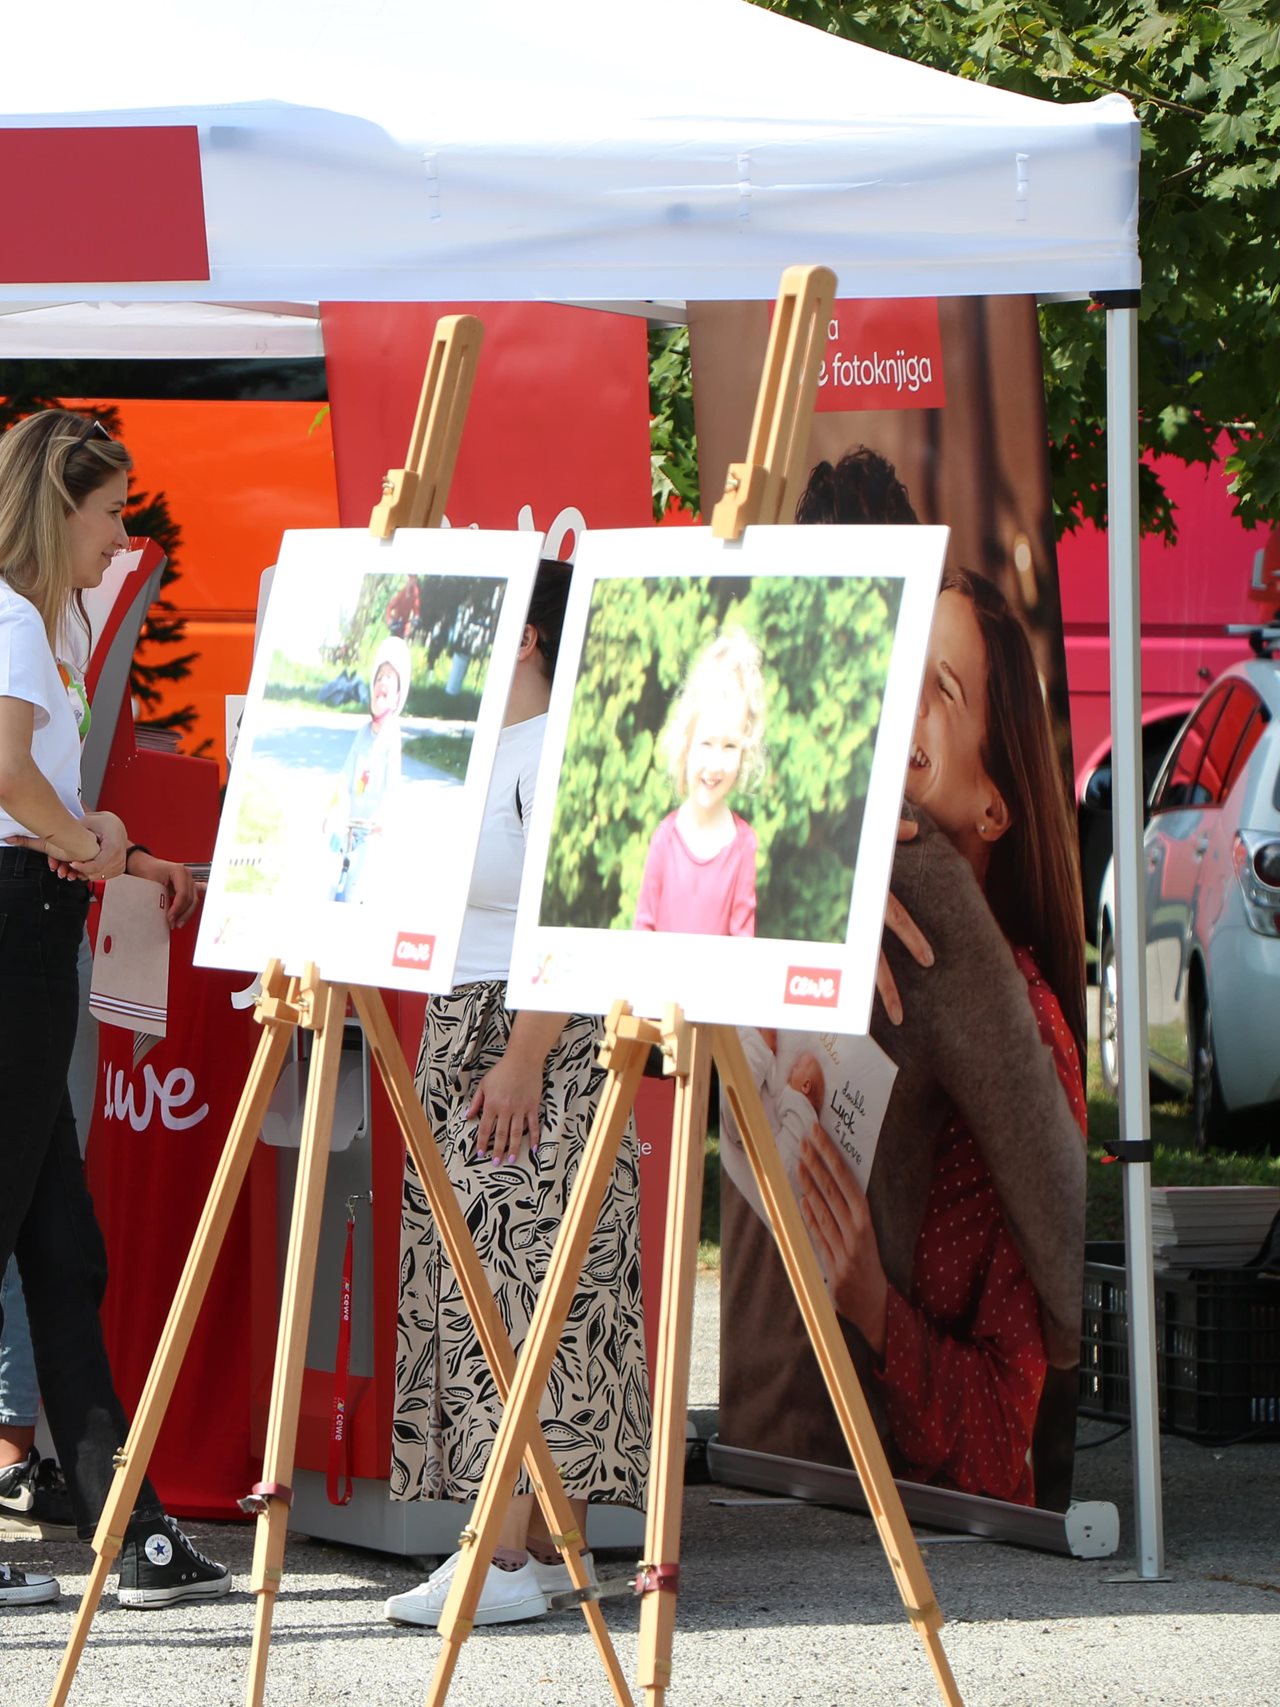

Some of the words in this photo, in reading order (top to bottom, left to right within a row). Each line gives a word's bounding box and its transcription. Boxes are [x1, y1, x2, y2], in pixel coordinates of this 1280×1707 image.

[832, 350, 932, 392] fotoknjiga
[104, 1060, 209, 1132] we
[830, 1090, 855, 1134] Luck
[840, 1133, 862, 1165] Love
[335, 1414, 344, 1441] cewe
